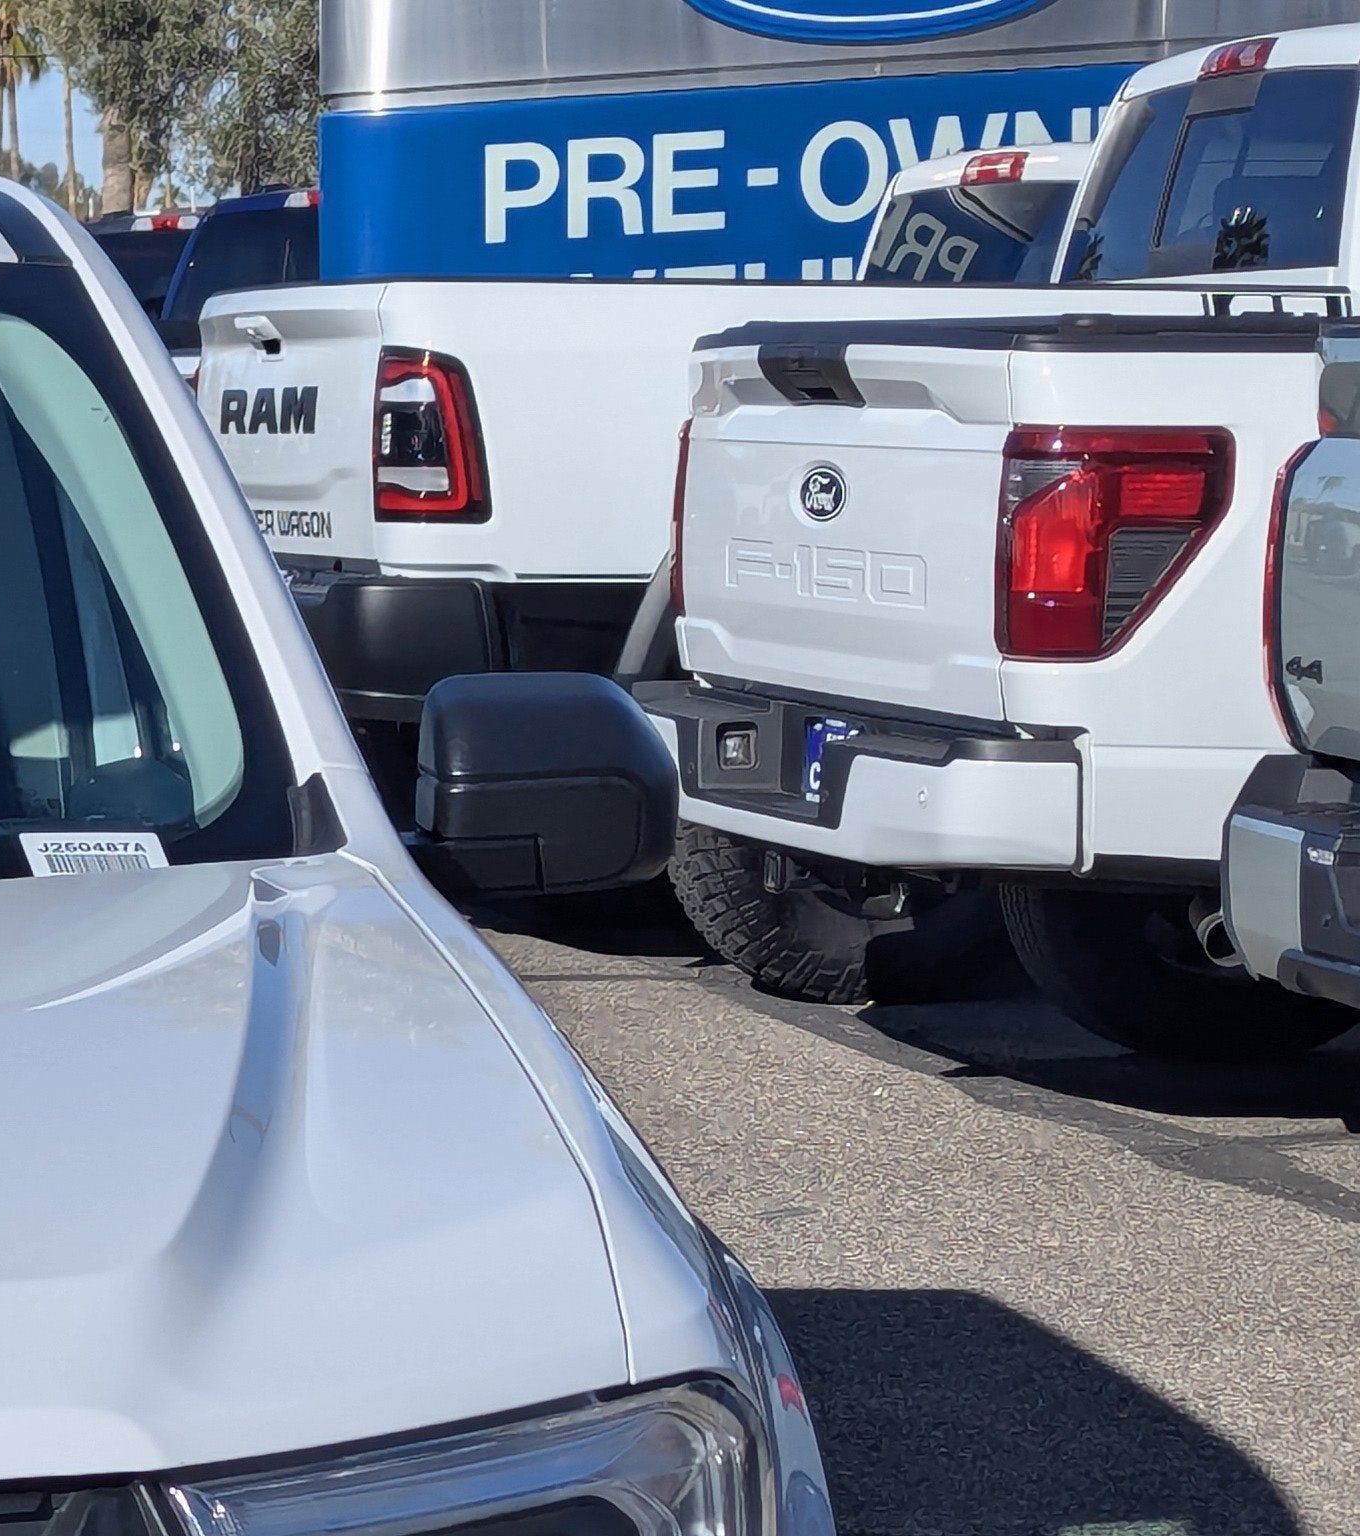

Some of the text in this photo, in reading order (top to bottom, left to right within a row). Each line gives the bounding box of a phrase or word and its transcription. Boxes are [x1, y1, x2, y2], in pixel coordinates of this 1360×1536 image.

[220, 386, 319, 434] RAM
[277, 510, 332, 539] WAGON
[725, 537, 927, 611] F-150
